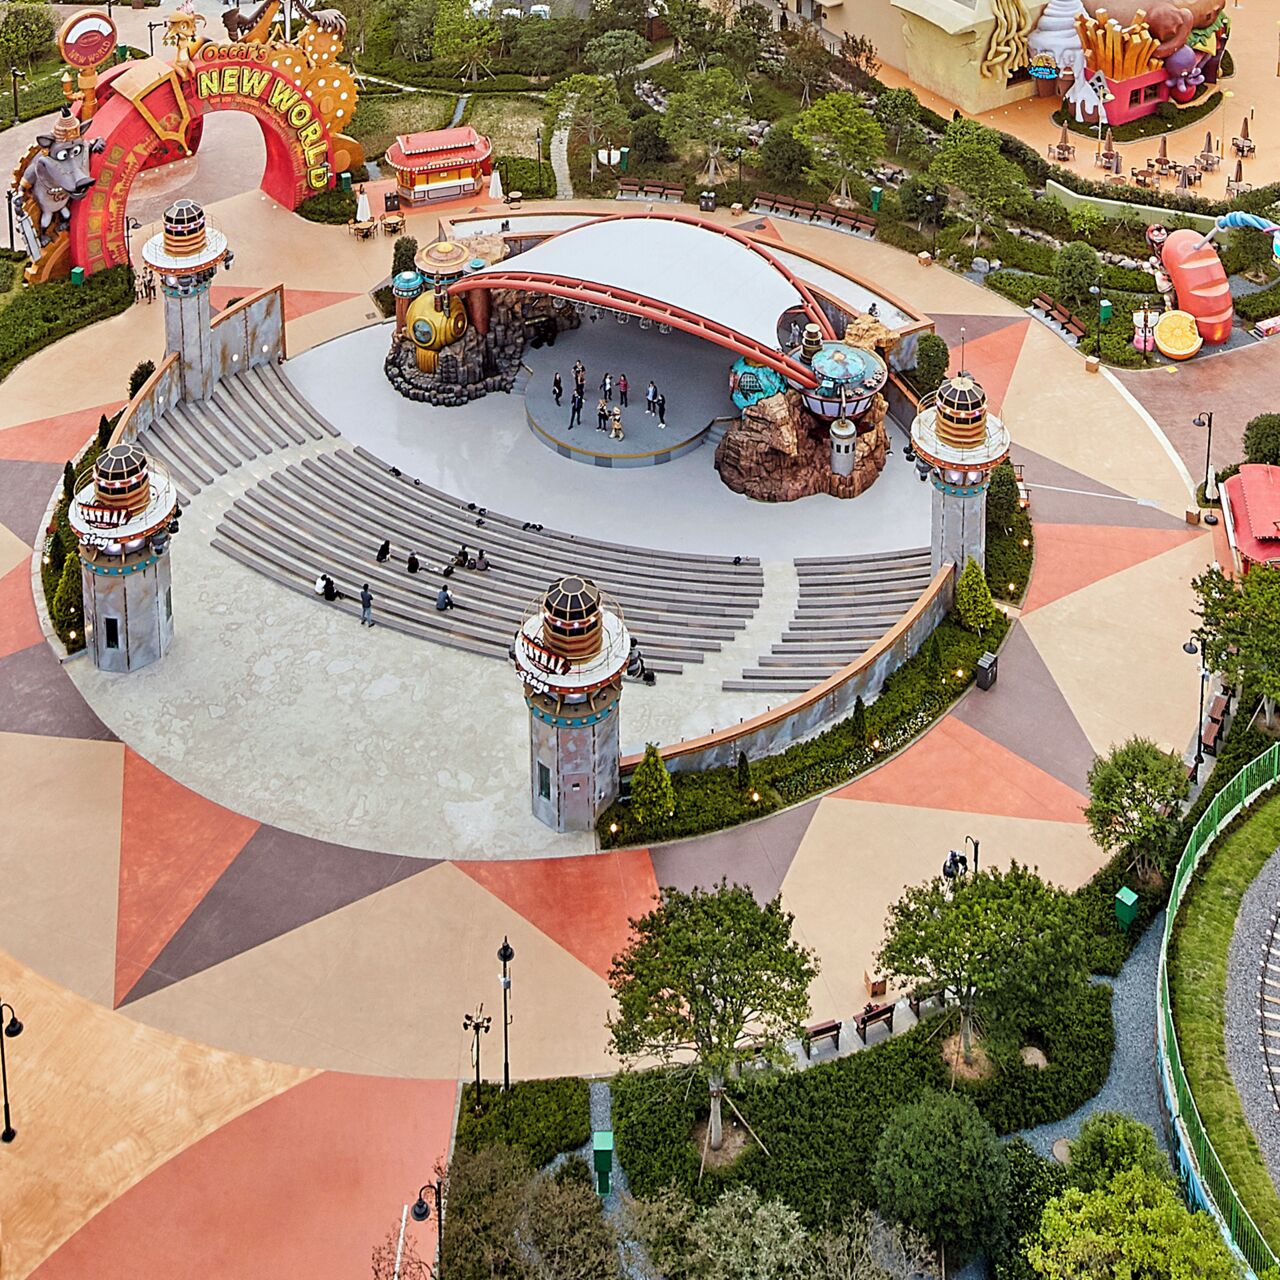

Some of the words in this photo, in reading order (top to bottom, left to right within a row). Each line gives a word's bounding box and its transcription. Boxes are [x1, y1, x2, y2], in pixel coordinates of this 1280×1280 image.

[200, 43, 268, 63] Oscar's
[198, 66, 272, 98] NEW
[268, 78, 330, 190] WORLD
[78, 532, 116, 551] Stage
[516, 670, 550, 695] Stage
